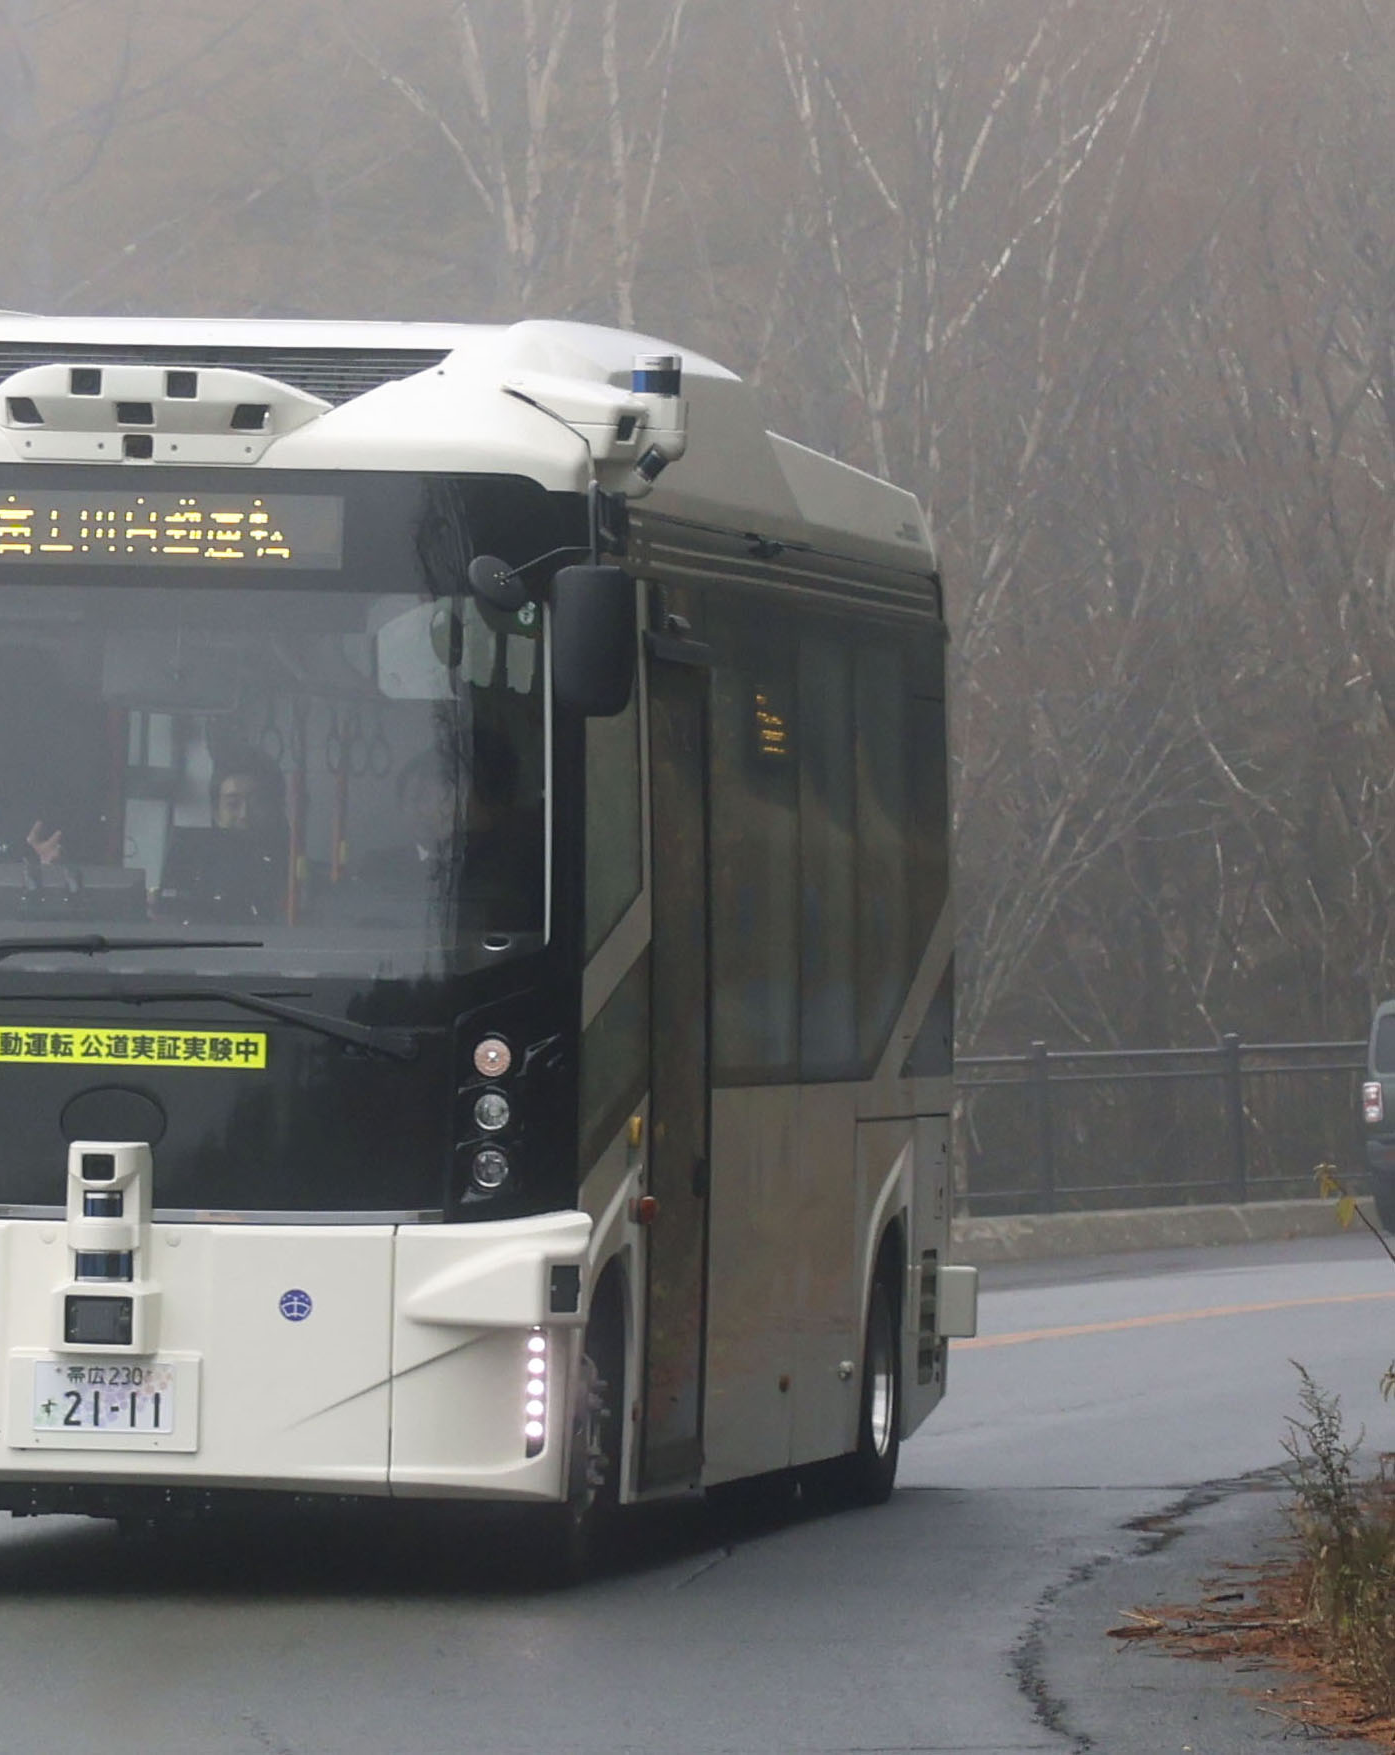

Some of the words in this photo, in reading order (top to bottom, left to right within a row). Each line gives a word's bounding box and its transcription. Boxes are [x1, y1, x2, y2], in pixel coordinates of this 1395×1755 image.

[79, 1034, 260, 1063] 公道実証実験中
[63, 1390, 162, 1428] 21-11
